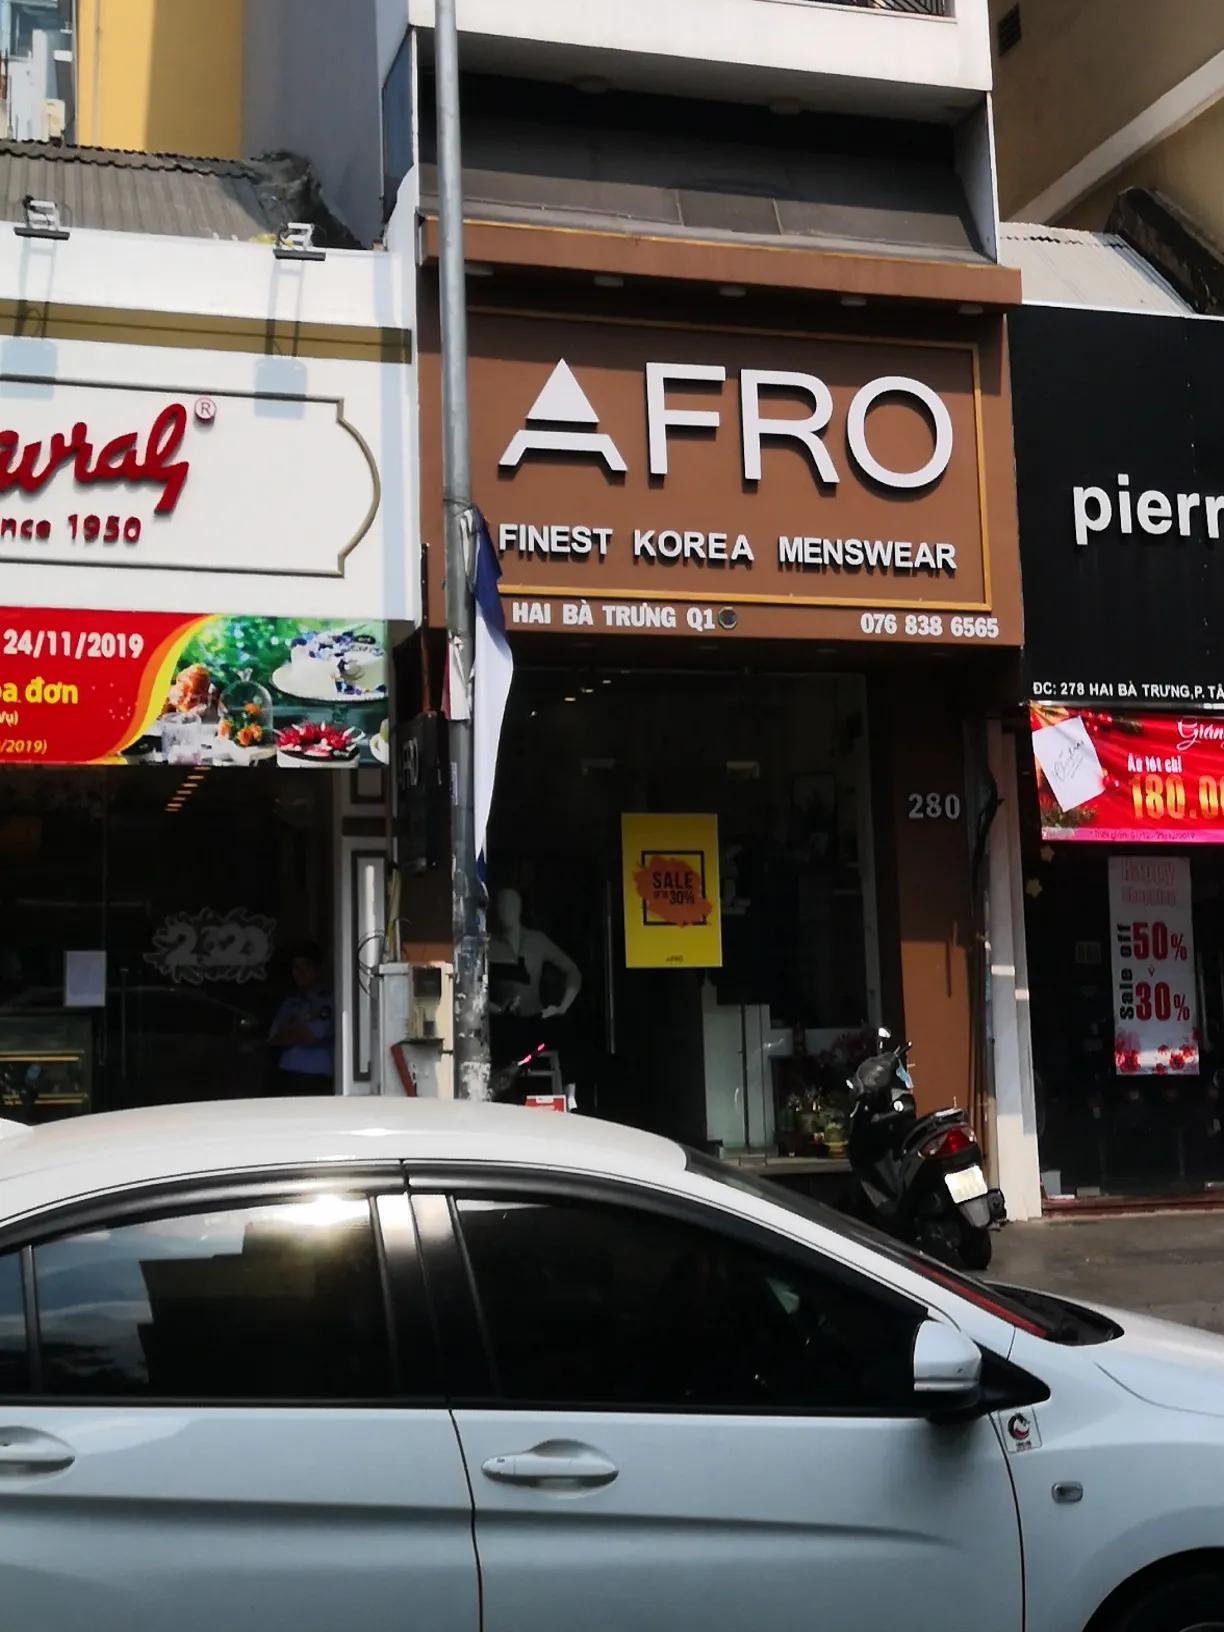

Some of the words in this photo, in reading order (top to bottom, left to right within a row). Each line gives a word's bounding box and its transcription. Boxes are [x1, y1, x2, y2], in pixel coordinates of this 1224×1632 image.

[498, 358, 954, 489] AFRO
[67, 514, 141, 543] 1950
[498, 523, 613, 556] FINEST
[634, 529, 755, 562] KOREA
[778, 536, 958, 570] MENSWEAR
[512, 601, 551, 624] HAI
[562, 599, 594, 626] BÀ
[602, 602, 677, 629] TRƯNG
[686, 606, 716, 632] Q1
[860, 612, 898, 635] 076
[905, 614, 943, 637] 838
[950, 616, 1000, 639] 6565
[3, 628, 145, 660] 24/11/2019
[25, 675, 79, 704] đơn
[1032, 681, 1057, 696] ĐC:
[1060, 682, 1085, 696] 278
[1089, 682, 1113, 697] HAI
[1117, 679, 1138, 698] BÀ
[908, 792, 961, 820] 280
[652, 871, 693, 889] SALE
[669, 890, 695, 905] 30%
[1132, 920, 1188, 962] 50%
[1135, 981, 1191, 1022] 30%
